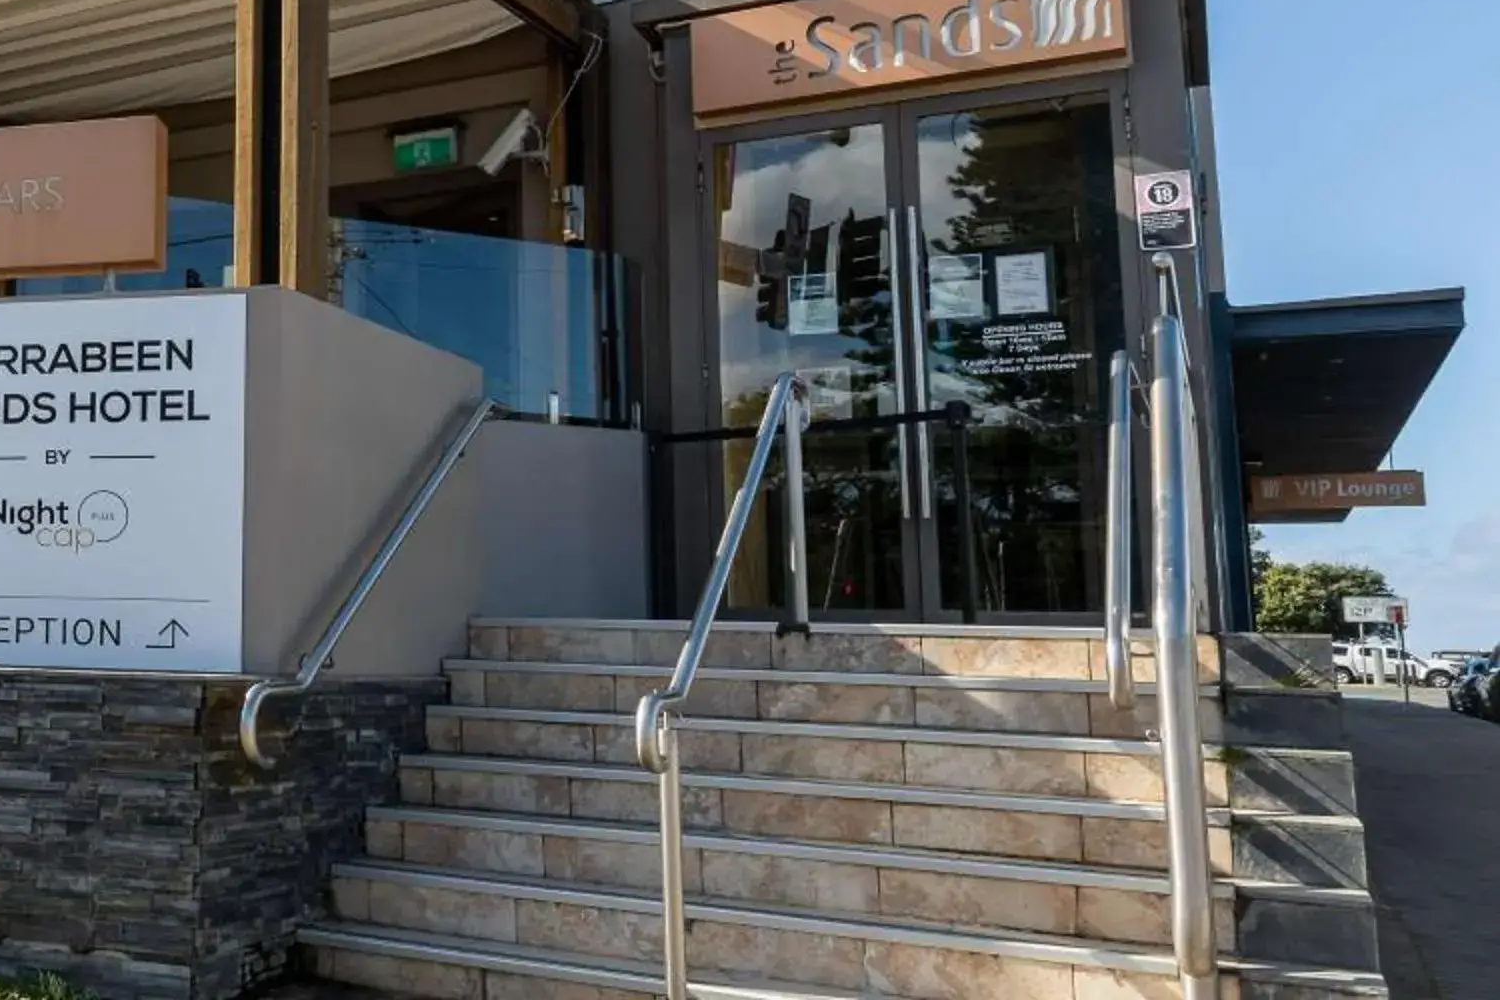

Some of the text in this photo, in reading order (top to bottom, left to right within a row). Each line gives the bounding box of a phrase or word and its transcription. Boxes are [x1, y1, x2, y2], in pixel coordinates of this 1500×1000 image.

[767, 38, 796, 86] the
[1153, 187, 1173, 203] 18
[69, 389, 211, 425] HOTEL
[44, 449, 72, 465] BY
[1294, 478, 1416, 500] VIP Lounge
[35, 526, 96, 555] cap
